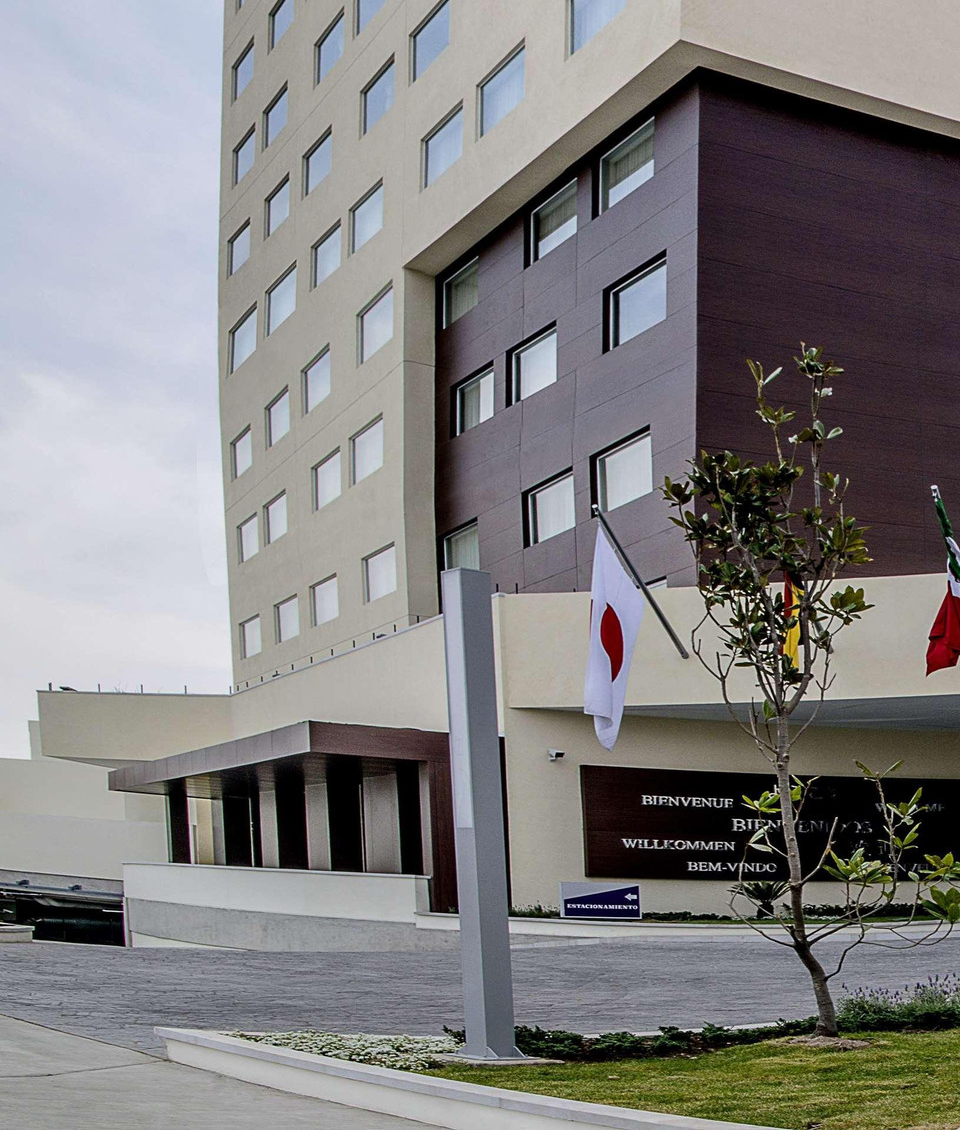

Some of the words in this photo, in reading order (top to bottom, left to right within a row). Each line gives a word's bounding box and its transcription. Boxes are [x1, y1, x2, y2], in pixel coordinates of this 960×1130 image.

[641, 795, 734, 809] BIENVENUE
[621, 838, 736, 851] WILLKOMMEN
[686, 861, 778, 872] BEM-VNDO
